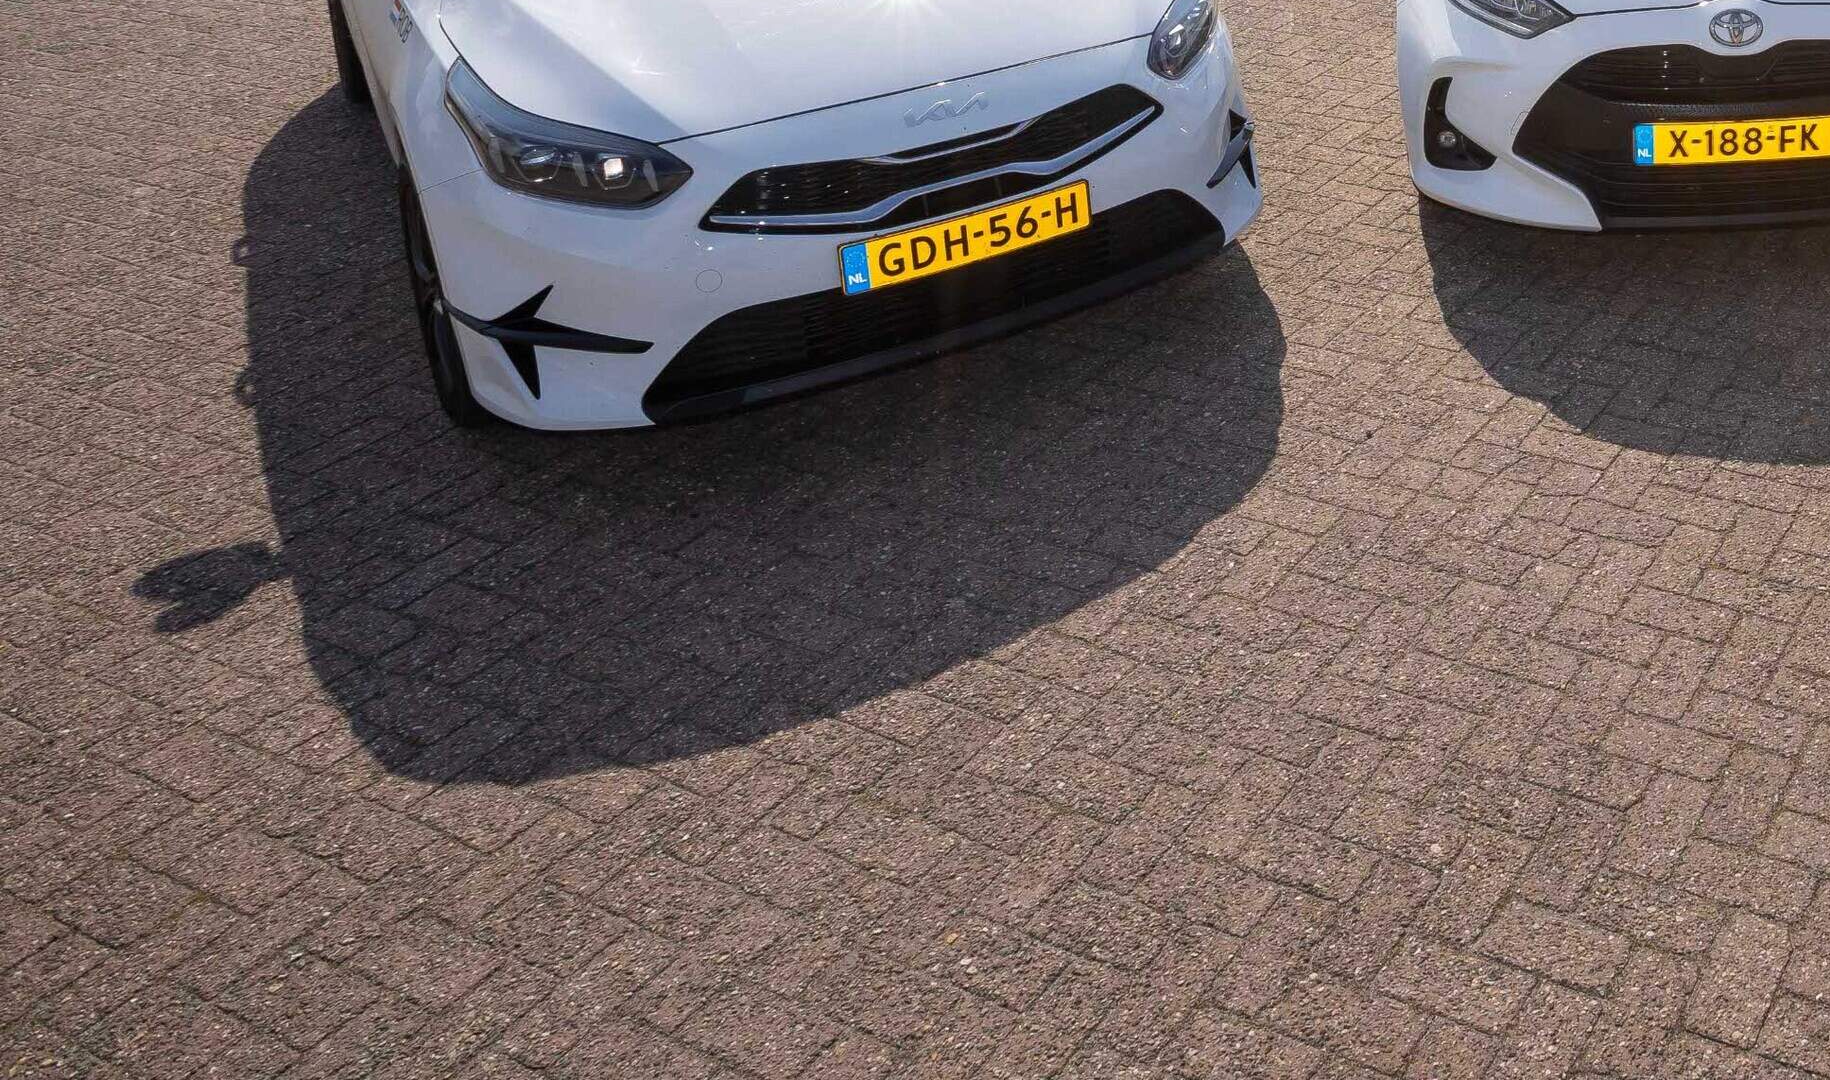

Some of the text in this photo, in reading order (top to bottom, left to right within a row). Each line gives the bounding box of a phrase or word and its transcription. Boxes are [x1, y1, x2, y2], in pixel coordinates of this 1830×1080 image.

[1637, 123, 1820, 158] NL X-188-FK
[848, 192, 1078, 286] NL GDH-56-H
